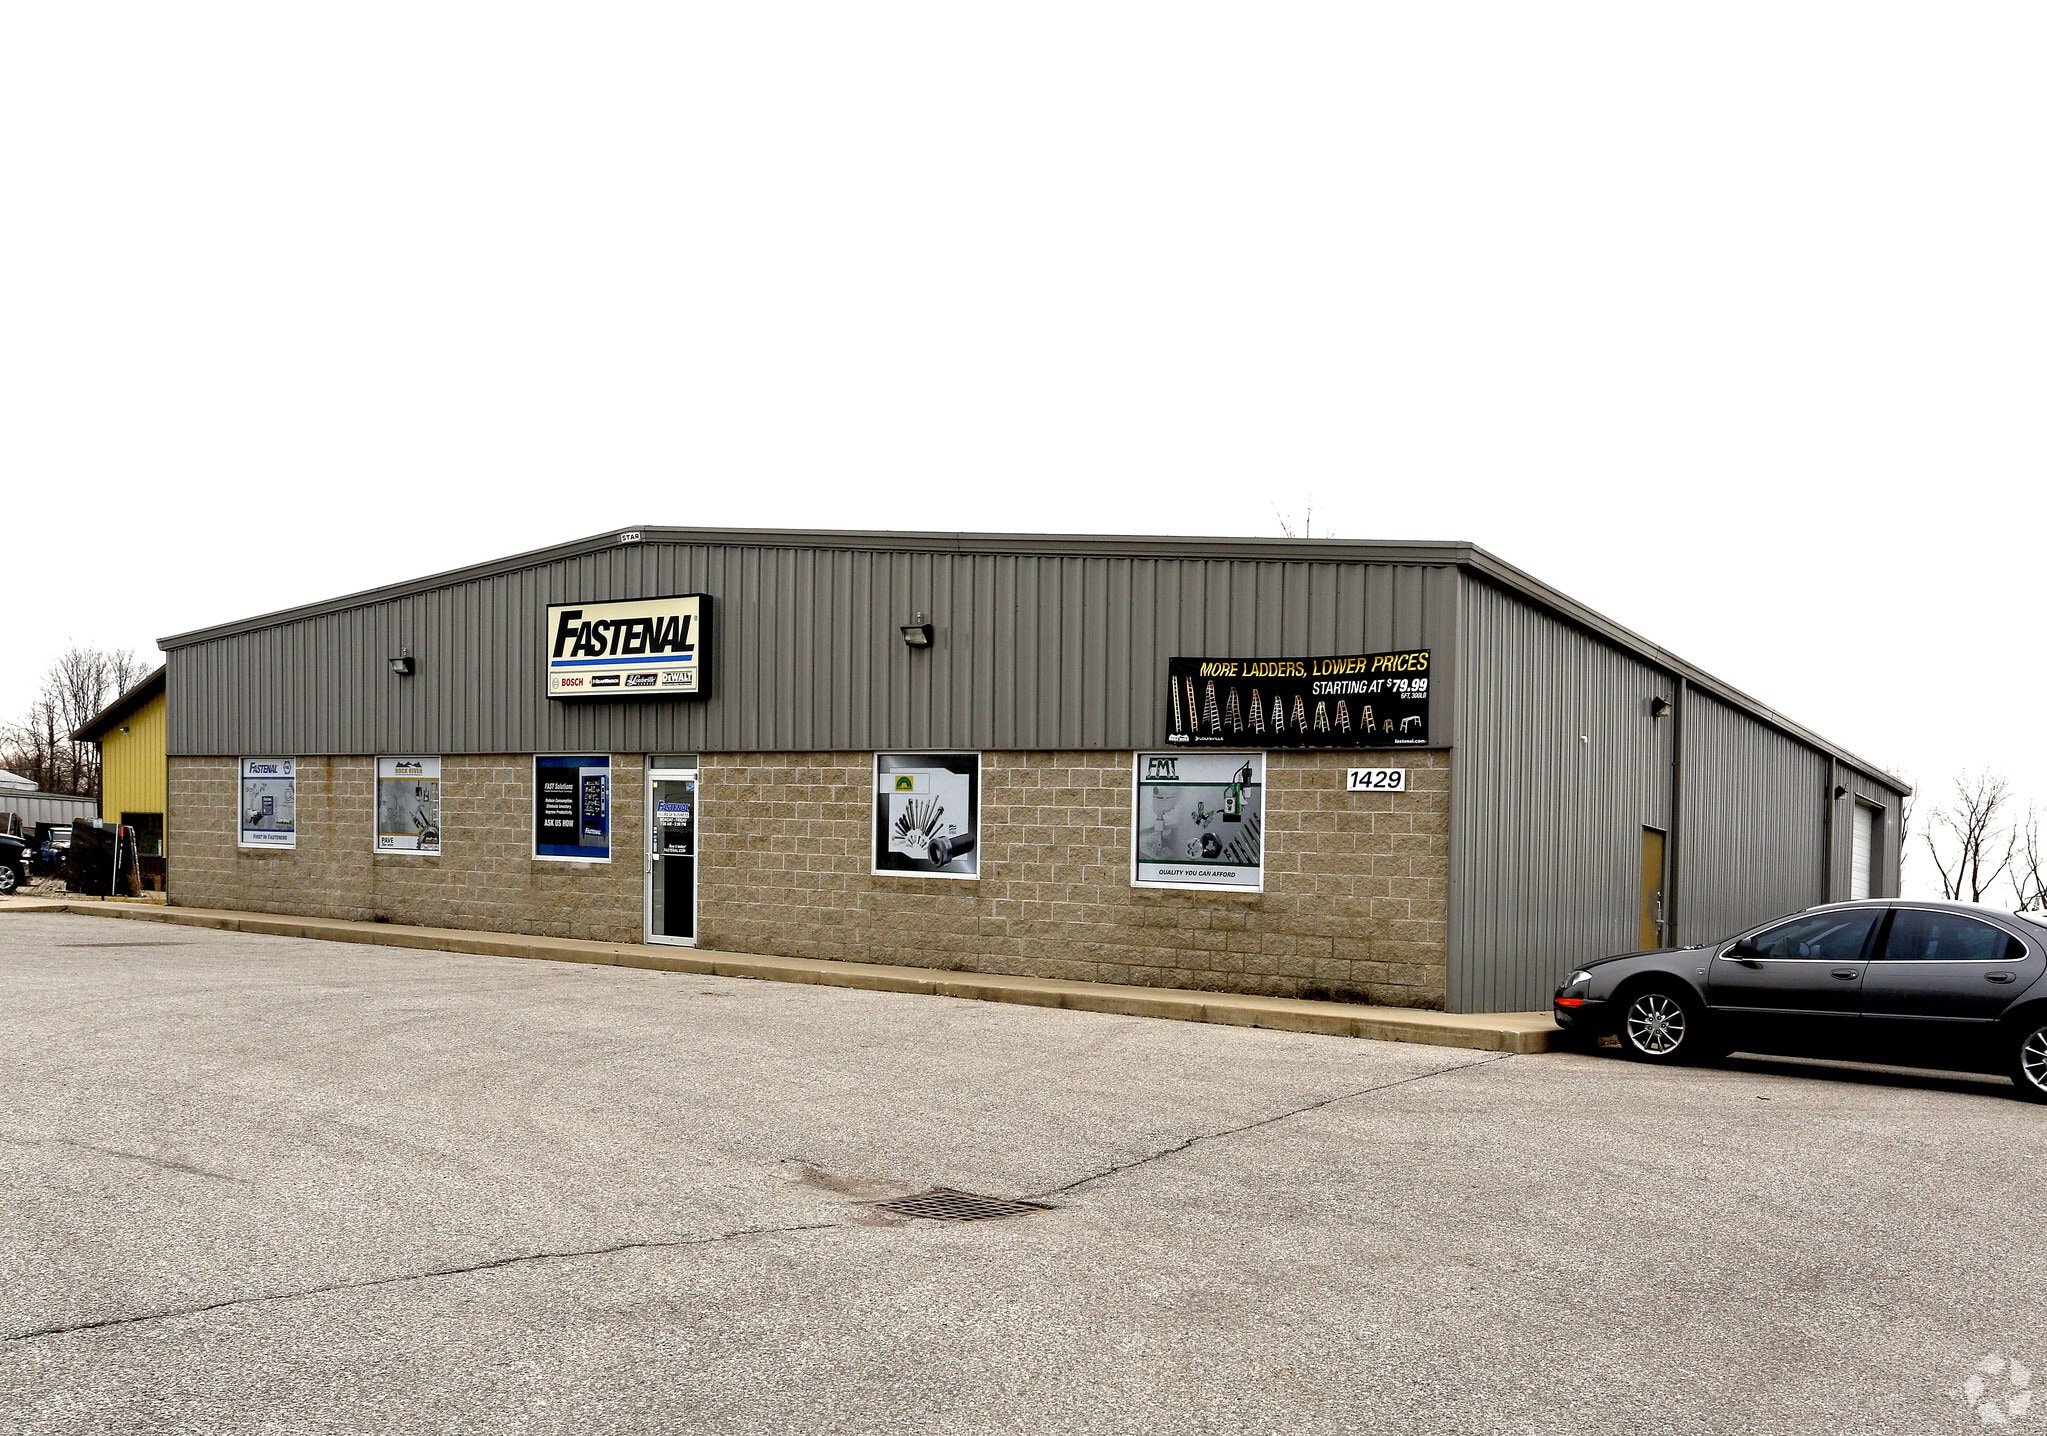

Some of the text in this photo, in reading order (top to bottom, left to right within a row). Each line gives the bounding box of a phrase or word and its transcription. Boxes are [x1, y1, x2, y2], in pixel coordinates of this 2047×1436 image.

[622, 533, 639, 541] STAR
[552, 609, 696, 658] FASTENAL
[1199, 652, 1429, 678] MORE LADDERS, LOWER PRICES
[561, 677, 584, 687] BOSCH
[1312, 678, 1428, 695] STARTING AT $79.99
[249, 762, 278, 774] FASTENAL
[1145, 757, 1179, 780] FMT
[544, 782, 574, 790] FAST Solutions
[1350, 771, 1402, 788] 1429
[544, 819, 554, 827] ASK
[555, 819, 562, 827] US
